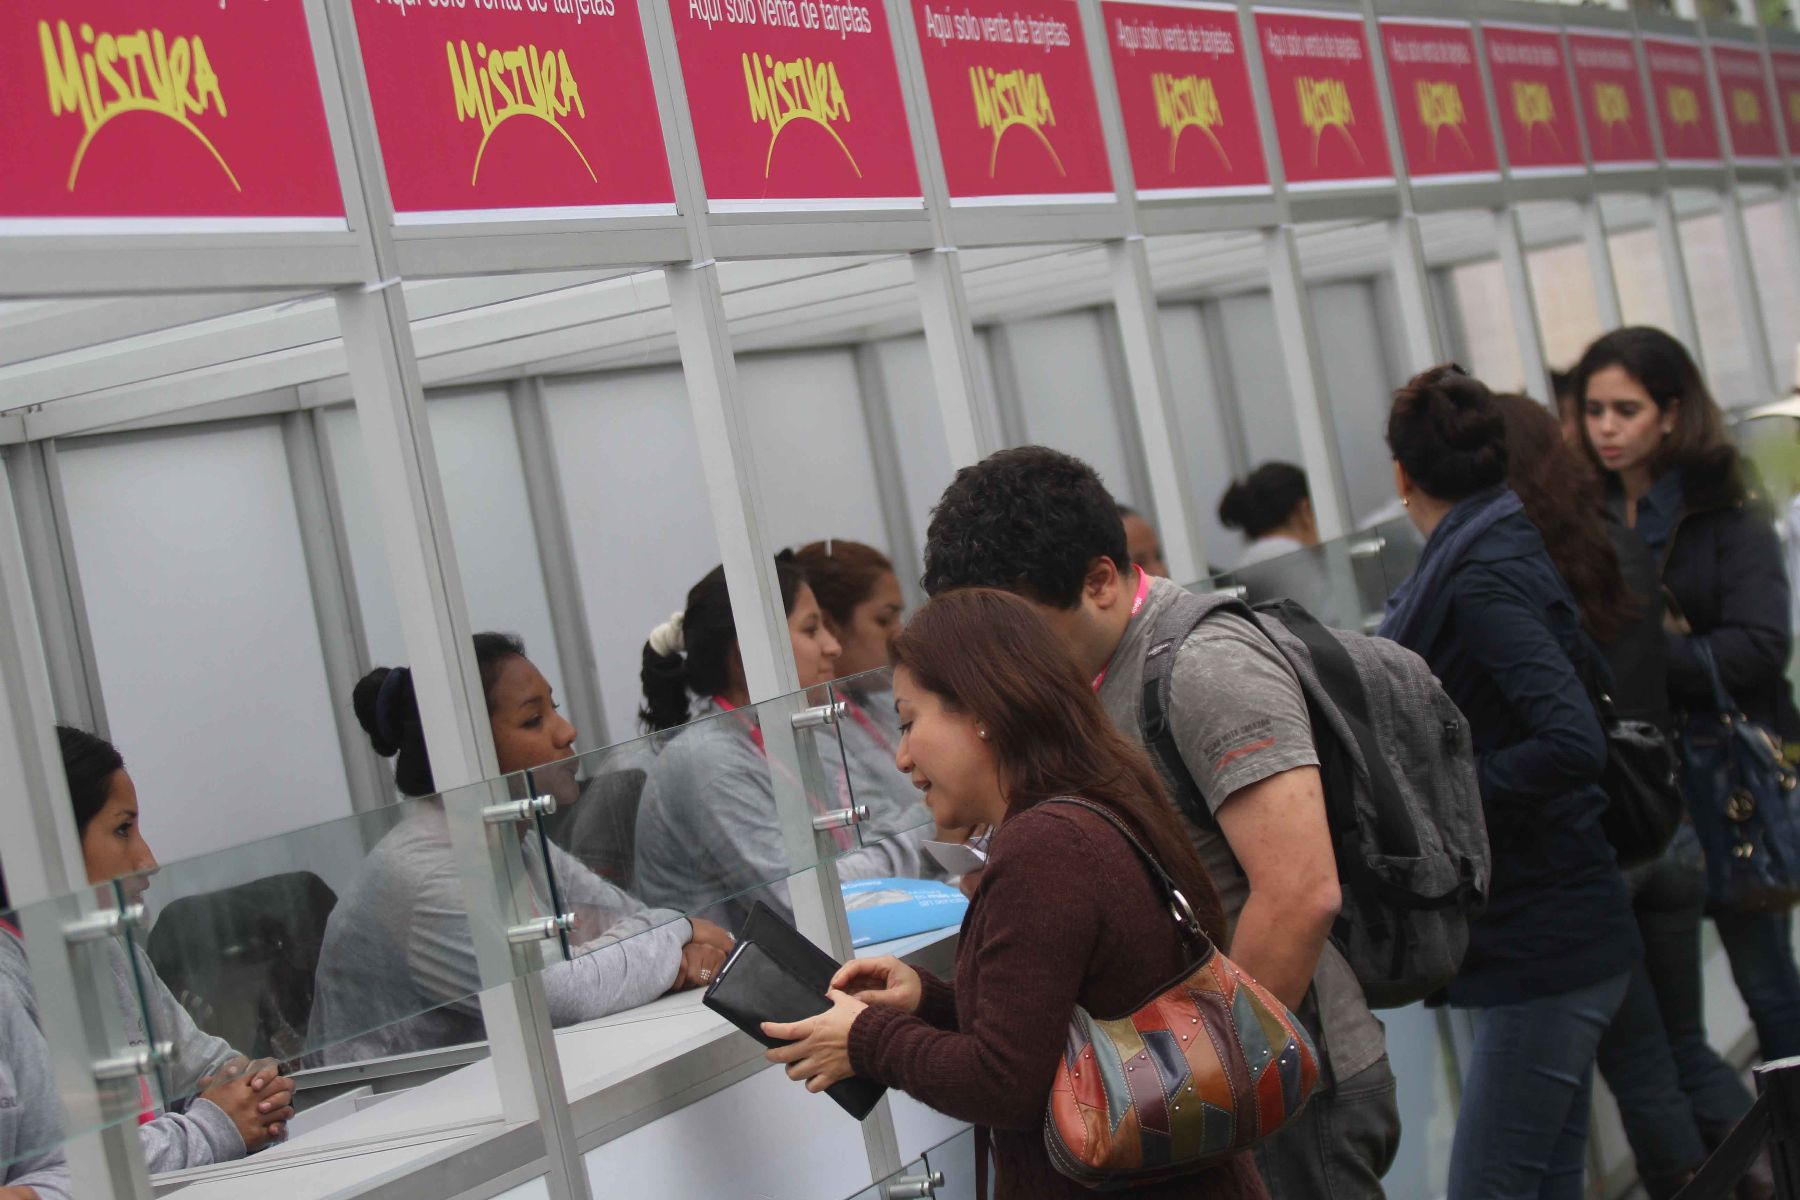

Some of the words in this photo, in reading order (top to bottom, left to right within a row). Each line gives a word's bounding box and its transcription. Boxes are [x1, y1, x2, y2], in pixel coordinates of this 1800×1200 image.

[758, 0, 800, 28] venta
[800, 0, 820, 30] de
[819, 0, 872, 41] tarjetas
[953, 8, 981, 41] solo
[979, 12, 1014, 43] venta
[1013, 12, 1029, 44] de
